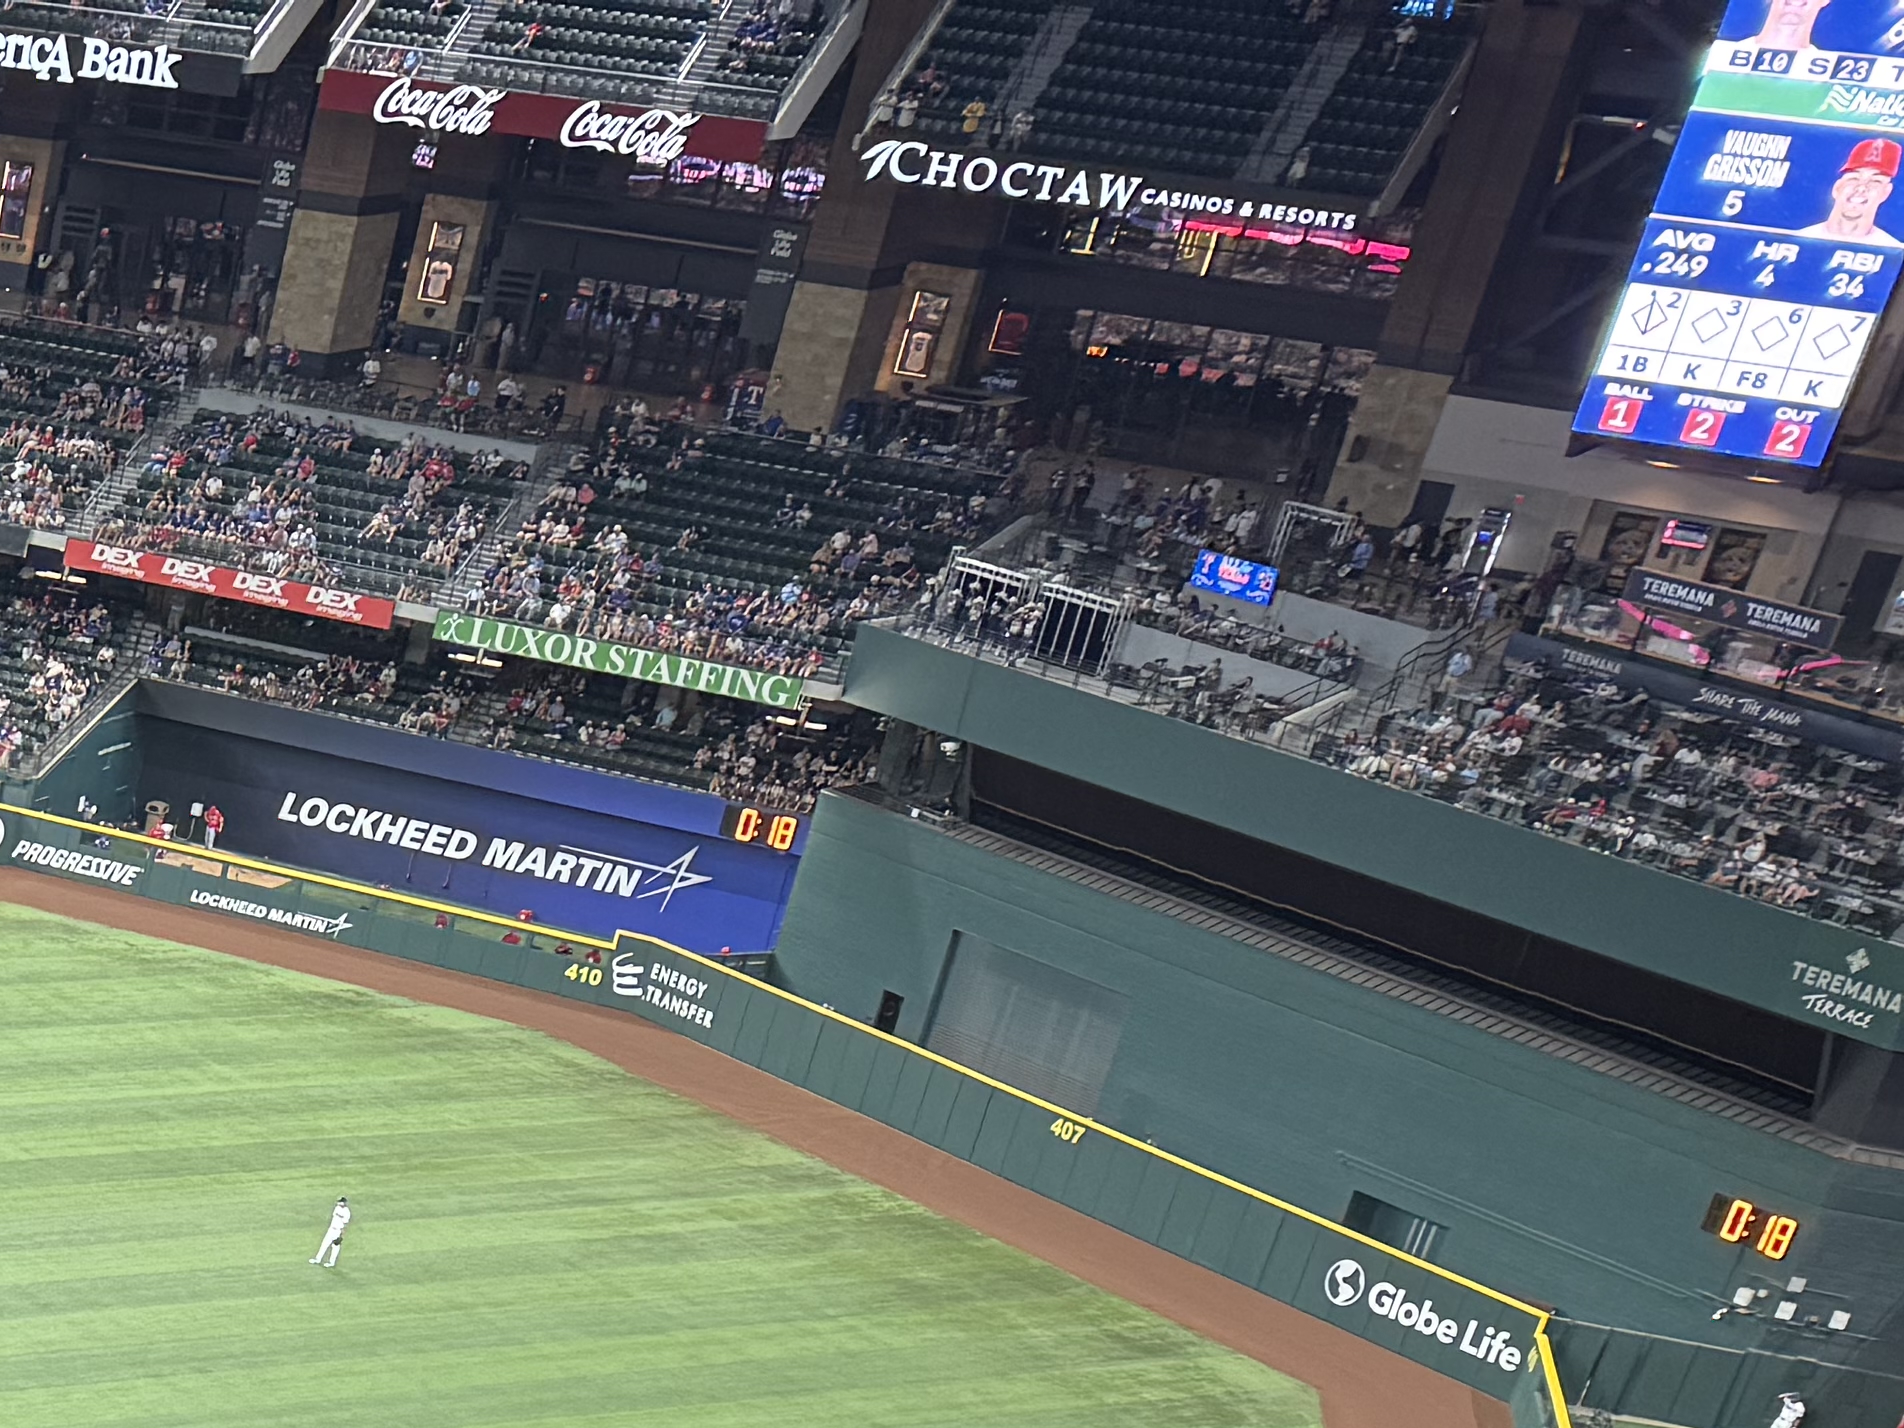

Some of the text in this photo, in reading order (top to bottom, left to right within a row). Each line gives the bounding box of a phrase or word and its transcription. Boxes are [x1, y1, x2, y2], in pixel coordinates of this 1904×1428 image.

[77, 37, 183, 88] Bank
[1729, 50, 1752, 67] B
[1758, 52, 1789, 73] 10
[1808, 58, 1830, 75] S
[1836, 59, 1869, 81] 23
[373, 76, 508, 136] Coca-Cola
[559, 100, 703, 161] Coca-Cola
[1723, 129, 1792, 160] VAUGHN
[888, 141, 1358, 230] CHOCTAW CASINOS & RESORTS
[1702, 153, 1791, 188] GRISSOM
[1722, 190, 1745, 217] 5
[1652, 229, 1885, 274] AVG HR RBI
[1641, 251, 1866, 300] .249 4 34
[1667, 291, 1867, 334] 2 3 6 7
[1617, 354, 1824, 398] 1B K F8 K
[1604, 382, 1821, 425] BALL STRIKE OUT
[1607, 400, 1801, 453] 1 2 2
[90, 544, 144, 569] DEX
[161, 557, 216, 583] DEX
[232, 571, 288, 597] DEX
[305, 585, 363, 612] DEX
[1643, 577, 1715, 608] TEREMANA
[1747, 603, 1822, 633] TEREMANA
[470, 618, 793, 708] LUXOR STAFFING
[278, 791, 644, 898] LOCKHEED MARTIN
[735, 807, 798, 851] 0:18
[12, 840, 142, 886] PROGRESSIVE
[190, 889, 328, 932] LOCKHEED MARTIN
[564, 963, 602, 987] 410
[650, 963, 708, 999] ENERGY
[1792, 961, 1903, 1014] TEREMANA
[646, 985, 714, 1029] TRANSFER
[1801, 994, 1875, 1029] TERRACE
[1051, 1118, 1086, 1144] 407
[1719, 1199, 1798, 1261] 0:18
[1368, 1281, 1459, 1344] Globe
[1459, 1319, 1522, 1372] Life
